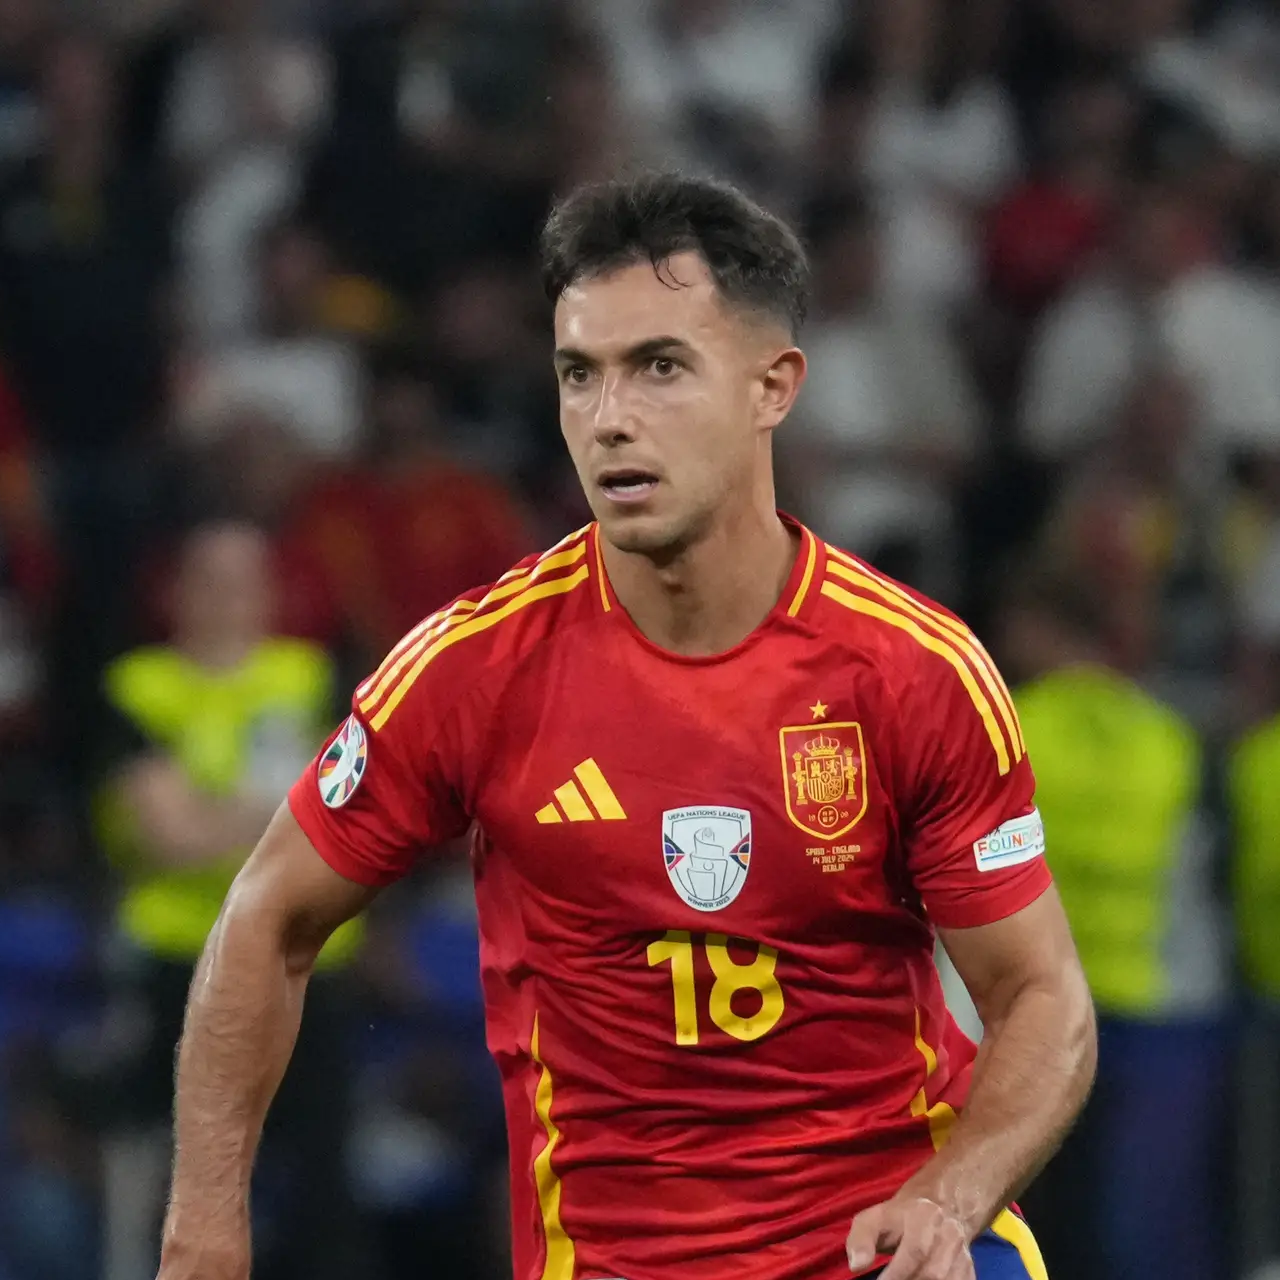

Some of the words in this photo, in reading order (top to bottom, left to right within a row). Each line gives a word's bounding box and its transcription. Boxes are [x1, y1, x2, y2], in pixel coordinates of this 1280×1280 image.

[667, 813, 685, 821] UEFA
[718, 811, 746, 820] LEAGUE
[821, 855, 837, 864] JULY
[687, 896, 714, 908] WINNER
[646, 929, 785, 1046] 18
